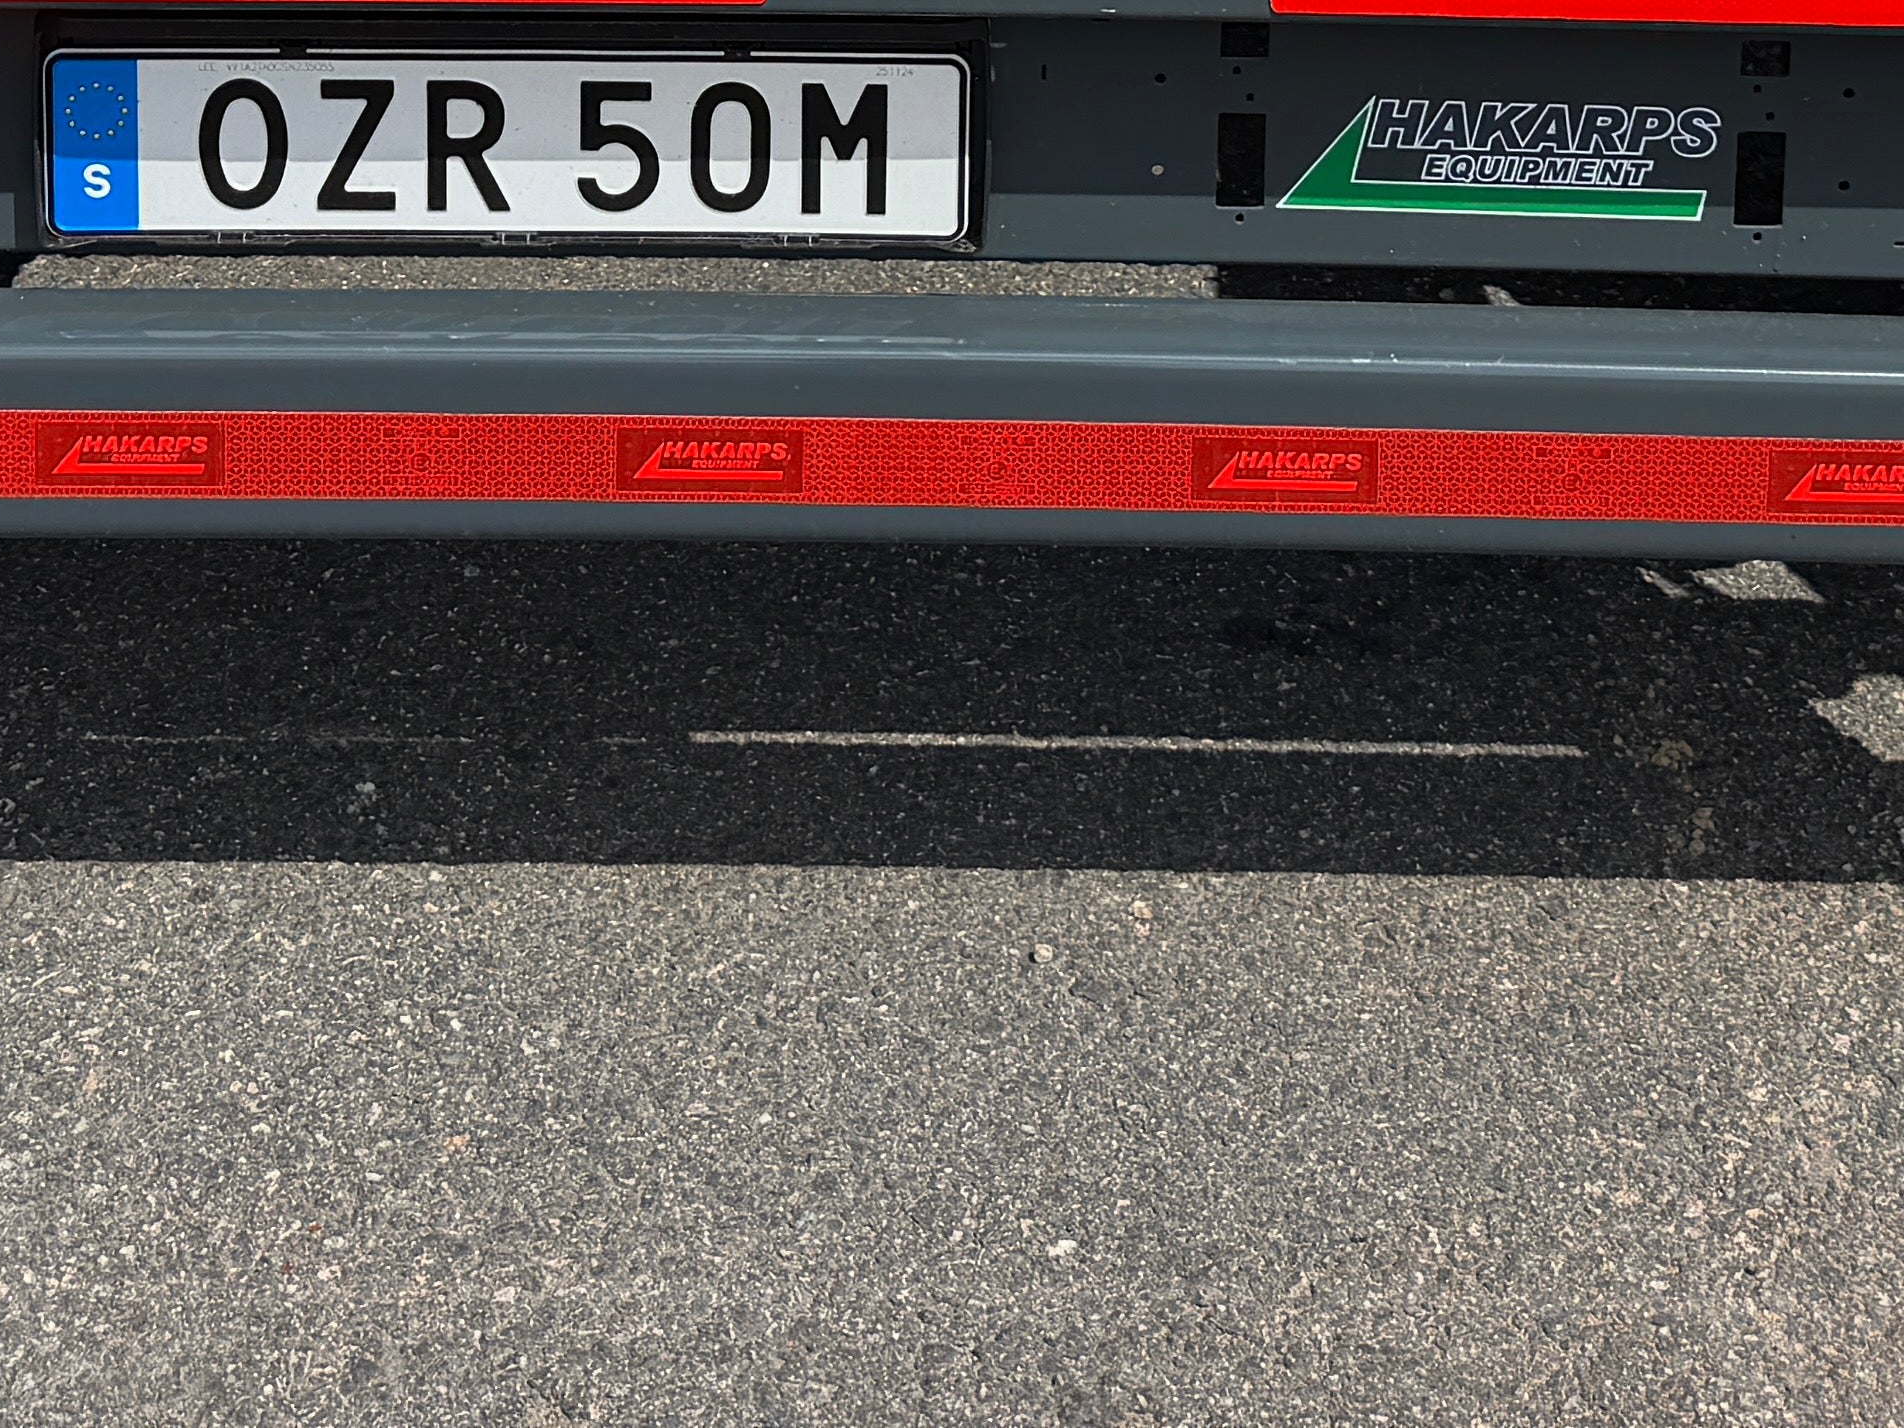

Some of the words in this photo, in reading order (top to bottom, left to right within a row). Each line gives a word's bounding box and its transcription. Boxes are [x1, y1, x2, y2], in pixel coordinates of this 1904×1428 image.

[1367, 98, 1723, 158] HAKARPS
[198, 78, 511, 212] OZR
[577, 80, 888, 215] 50M
[83, 163, 111, 199] S
[1420, 154, 1655, 187] EQUIPMENT
[82, 434, 208, 454] HAKARPS
[663, 441, 789, 461] HAKARPS
[1238, 450, 1363, 471] HAKARPS
